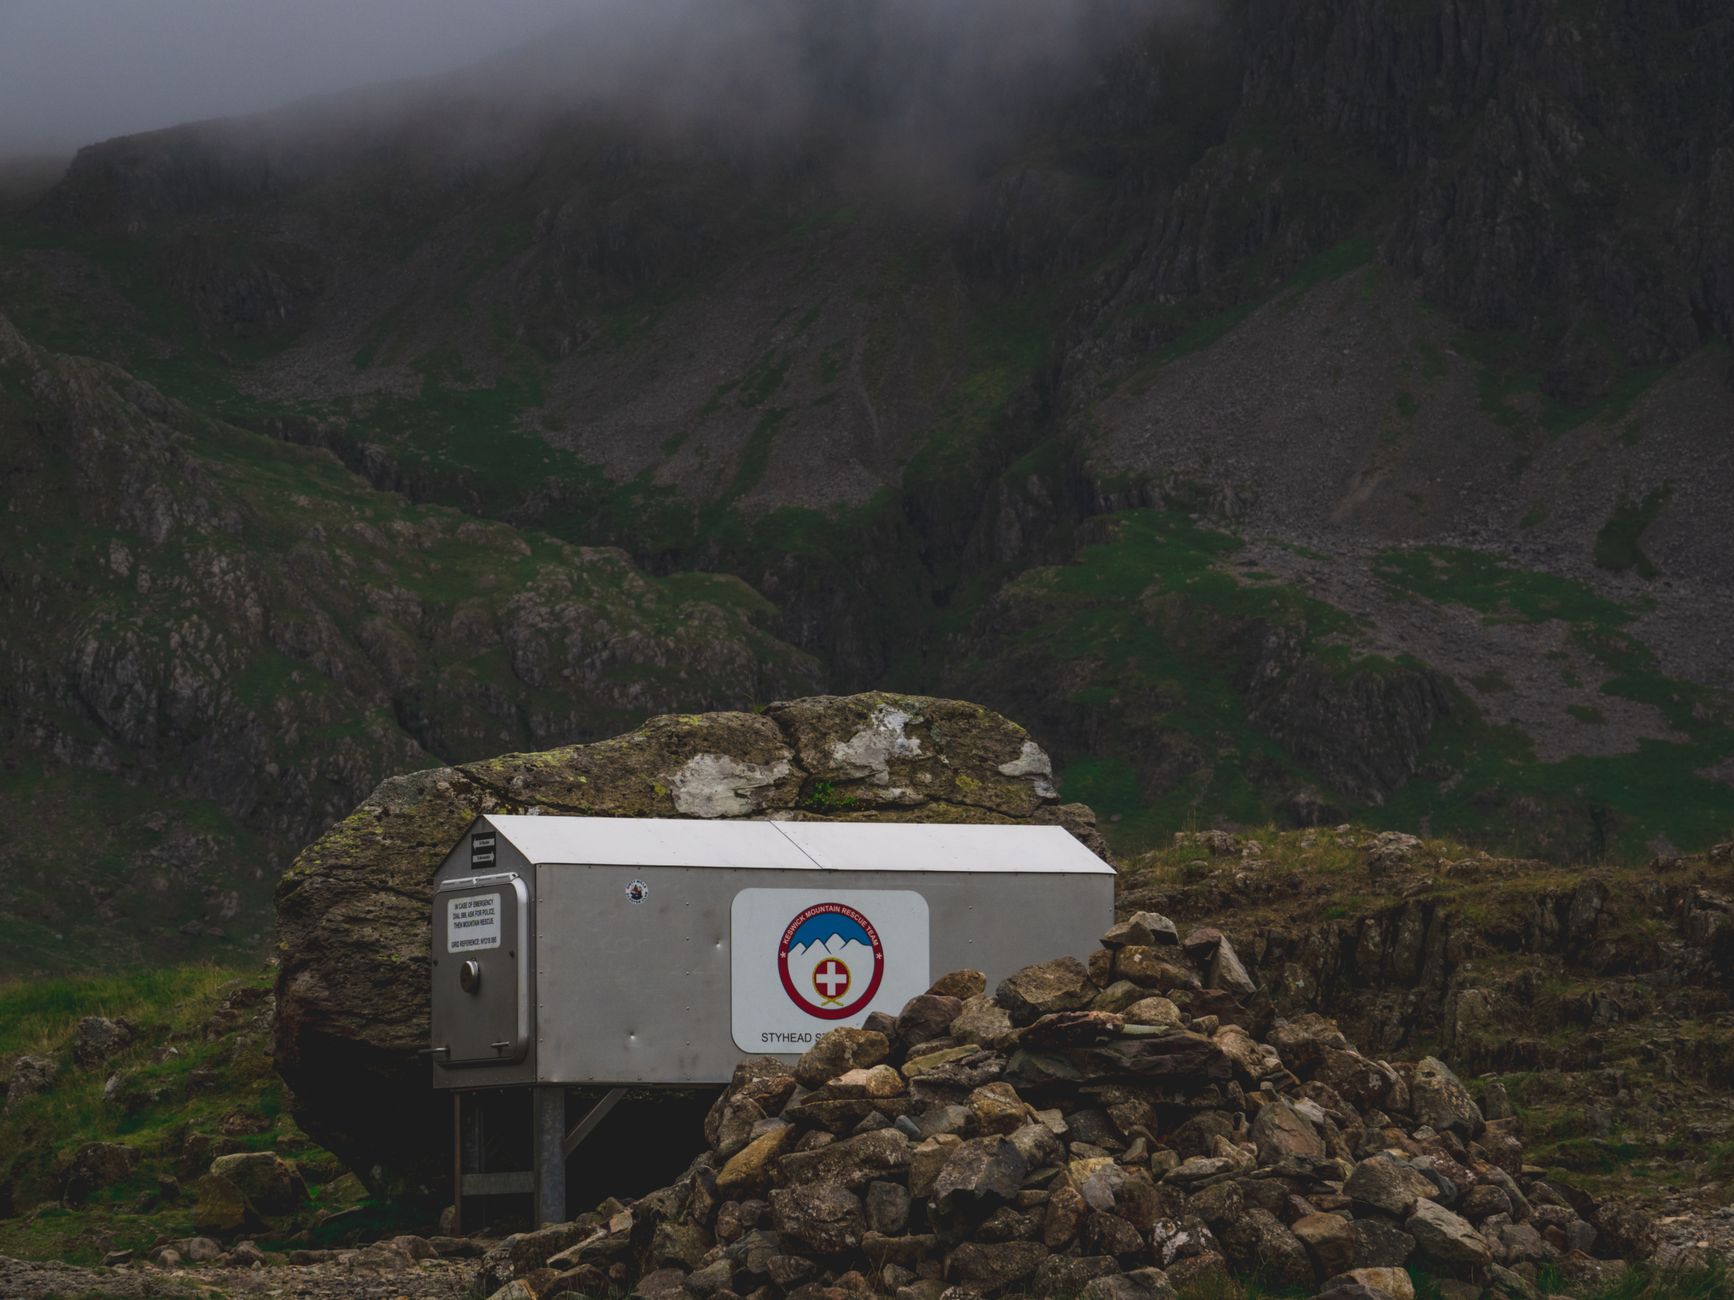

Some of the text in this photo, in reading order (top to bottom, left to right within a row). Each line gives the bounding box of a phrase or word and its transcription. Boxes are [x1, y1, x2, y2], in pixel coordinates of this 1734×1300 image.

[782, 905, 879, 946] KESWICK MOUNTAIN RESCUE TEAM
[761, 1032, 812, 1043] STYHEAD
